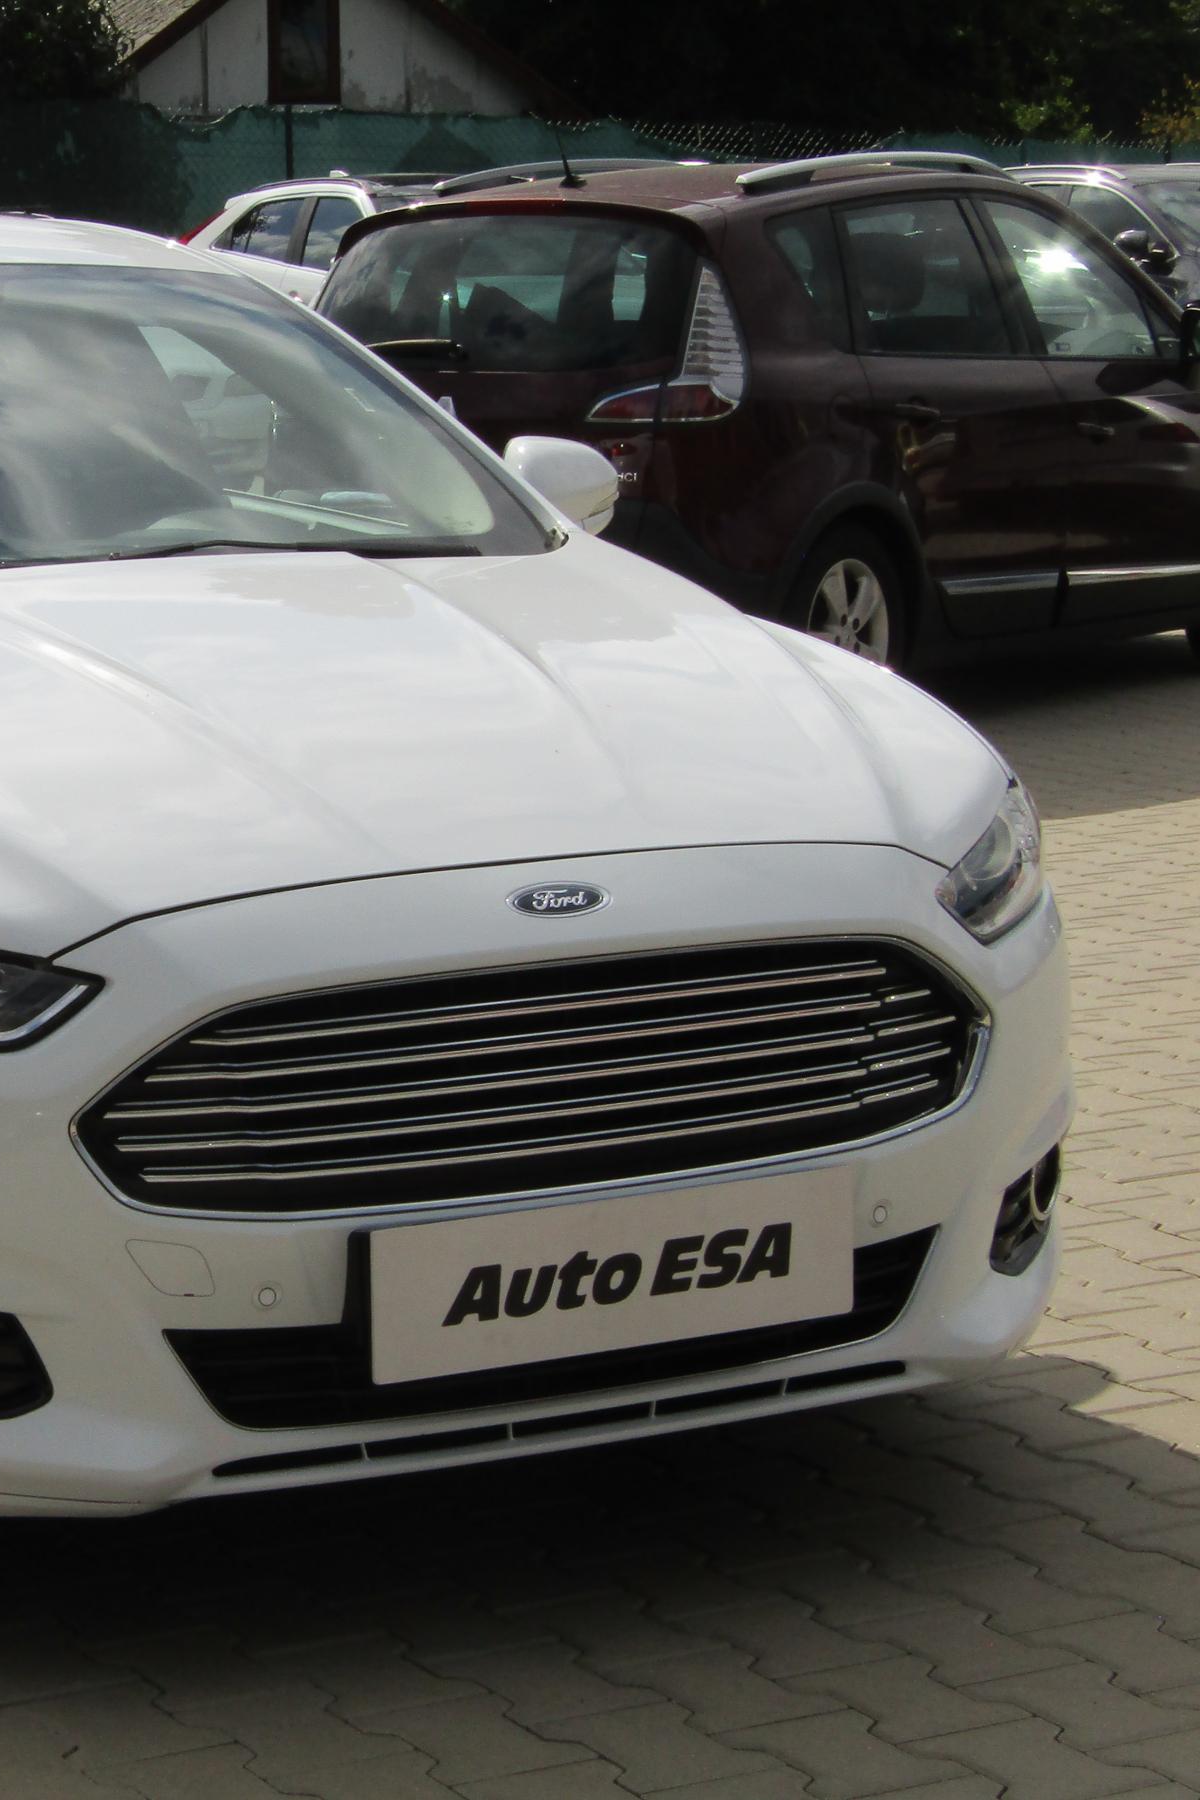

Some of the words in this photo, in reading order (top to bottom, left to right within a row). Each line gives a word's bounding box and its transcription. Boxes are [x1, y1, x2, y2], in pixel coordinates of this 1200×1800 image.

[532, 889, 588, 910] Ford
[441, 1250, 642, 1328] Auto
[650, 1222, 792, 1297] ESA
